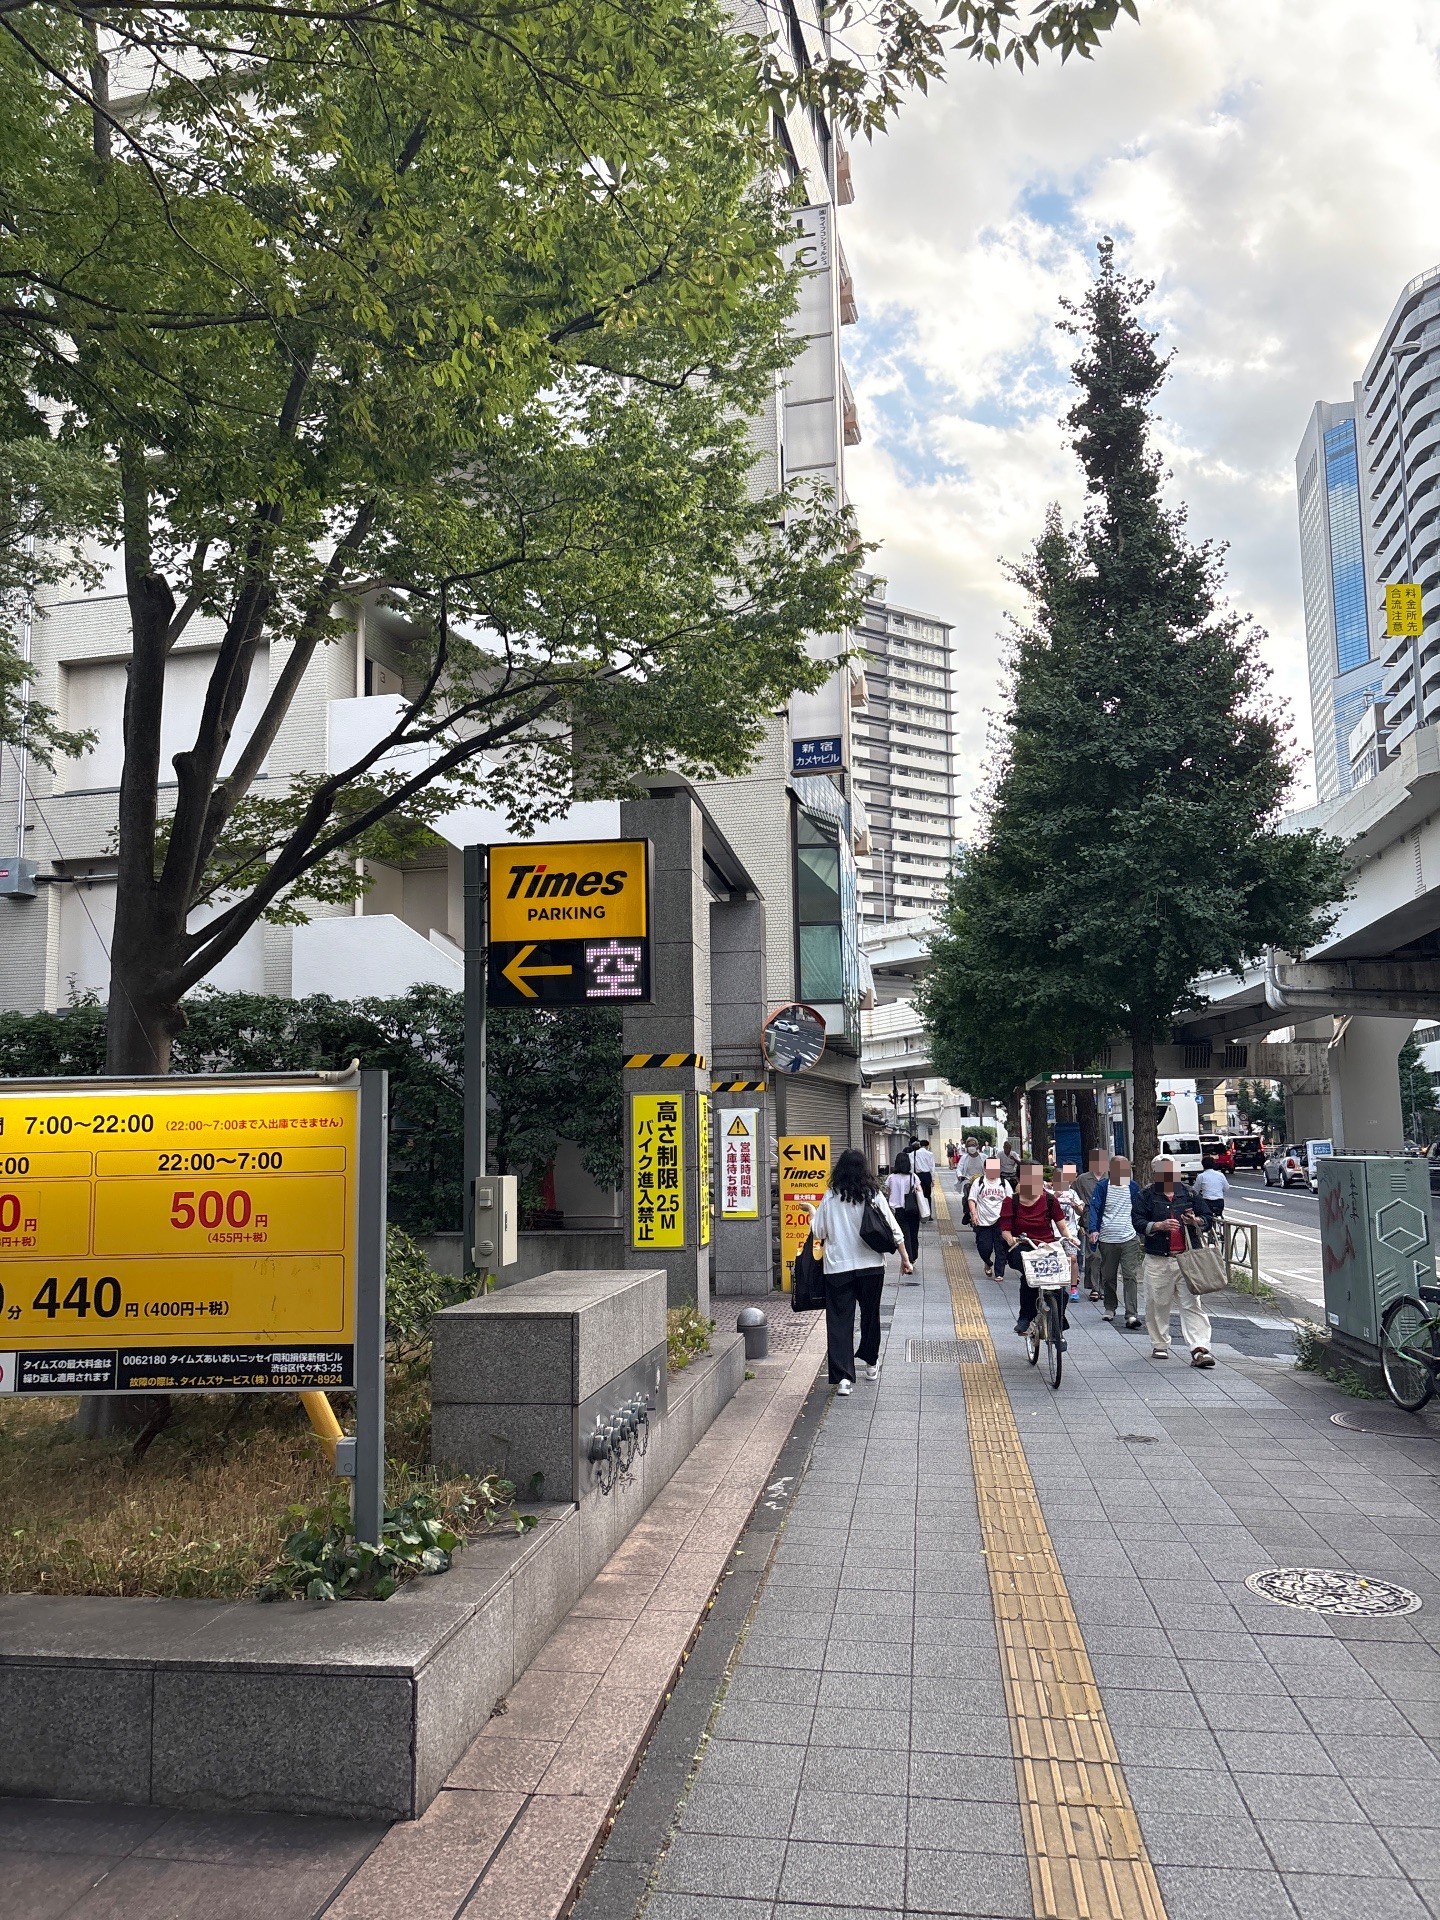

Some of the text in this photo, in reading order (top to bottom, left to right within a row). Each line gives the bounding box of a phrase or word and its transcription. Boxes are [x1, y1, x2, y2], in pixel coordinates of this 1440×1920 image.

[1391, 588, 1402, 632] 合流注意
[1405, 588, 1418, 632] 料金所先
[796, 754, 840, 766] カメヤビル
[507, 865, 628, 899] Times
[528, 906, 605, 921] PARKING
[586, 940, 642, 997] 空
[804, 1144, 826, 1161] IN
[727, 1142, 738, 1208] 入庫待ち禁止
[740, 1142, 751, 1197] 営業時間前
[783, 1167, 826, 1180] Times
[638, 1120, 654, 1241] バイク進入禁止
[23, 1358, 112, 1370] タイムズの最大料金は
[123, 1352, 343, 1365] 0062180 タイムズあいおいニッセイ同和損保新宿ビル
[271, 1363, 343, 1373] 渋谷区代々木3-25
[23, 1372, 110, 1384] 繰り返し適用されます
[272, 1374, 342, 1385] 0120-77-8924
